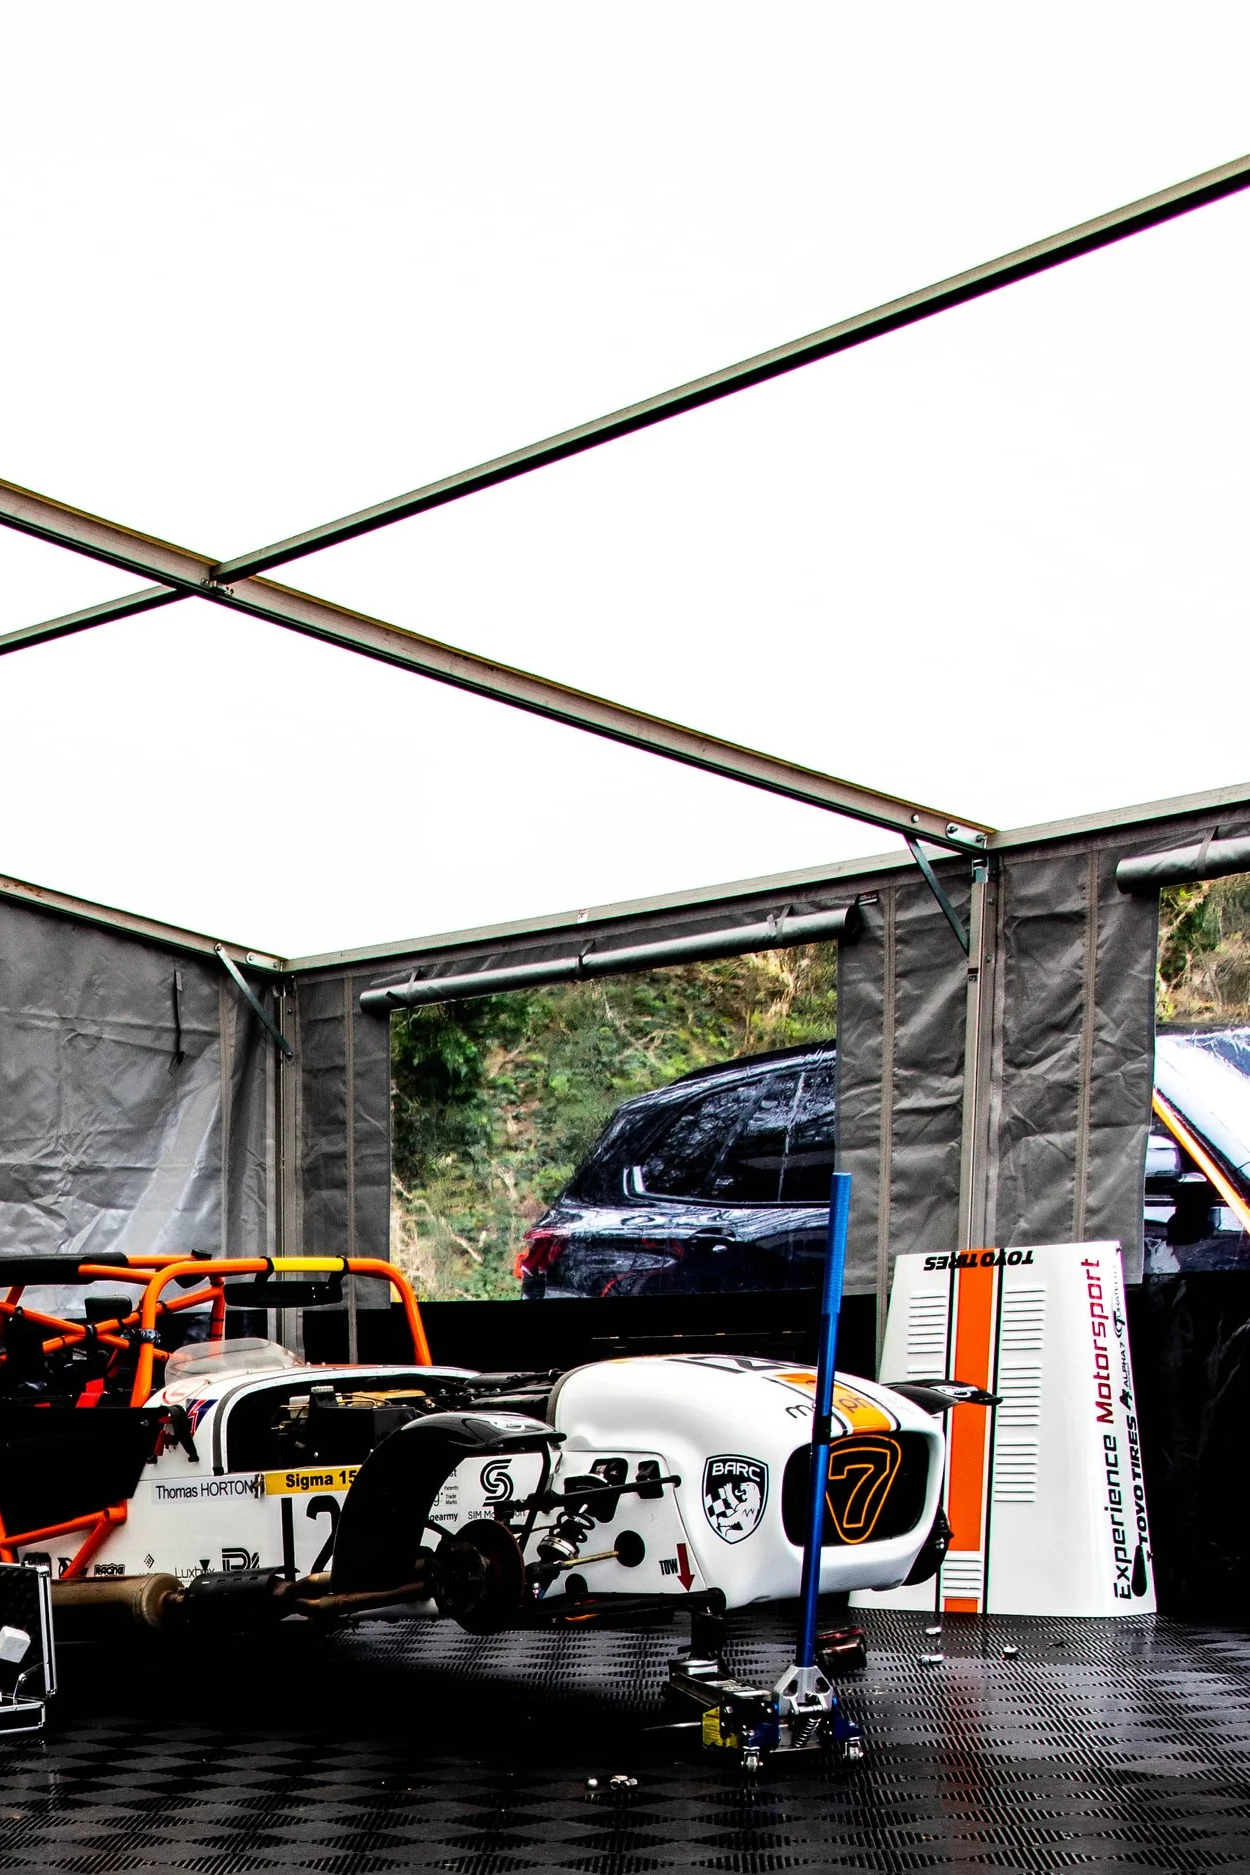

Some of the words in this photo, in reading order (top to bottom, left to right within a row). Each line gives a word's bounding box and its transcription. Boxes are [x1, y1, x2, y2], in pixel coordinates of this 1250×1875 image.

[923, 1253, 979, 1271] TIRES
[980, 1250, 1034, 1268] TOYO
[1081, 1258, 1114, 1424] Motorsport
[1126, 1414, 1141, 1481] TIRES
[285, 1473, 334, 1490] Sigma
[711, 1461, 761, 1482] BARC
[156, 1485, 198, 1500] Thomas
[200, 1480, 253, 1497] HORTON
[468, 1511, 481, 1519] SIM
[1103, 1434, 1132, 1600] Experience
[1133, 1484, 1148, 1546] TOYO
[658, 1558, 679, 1576] TOW
